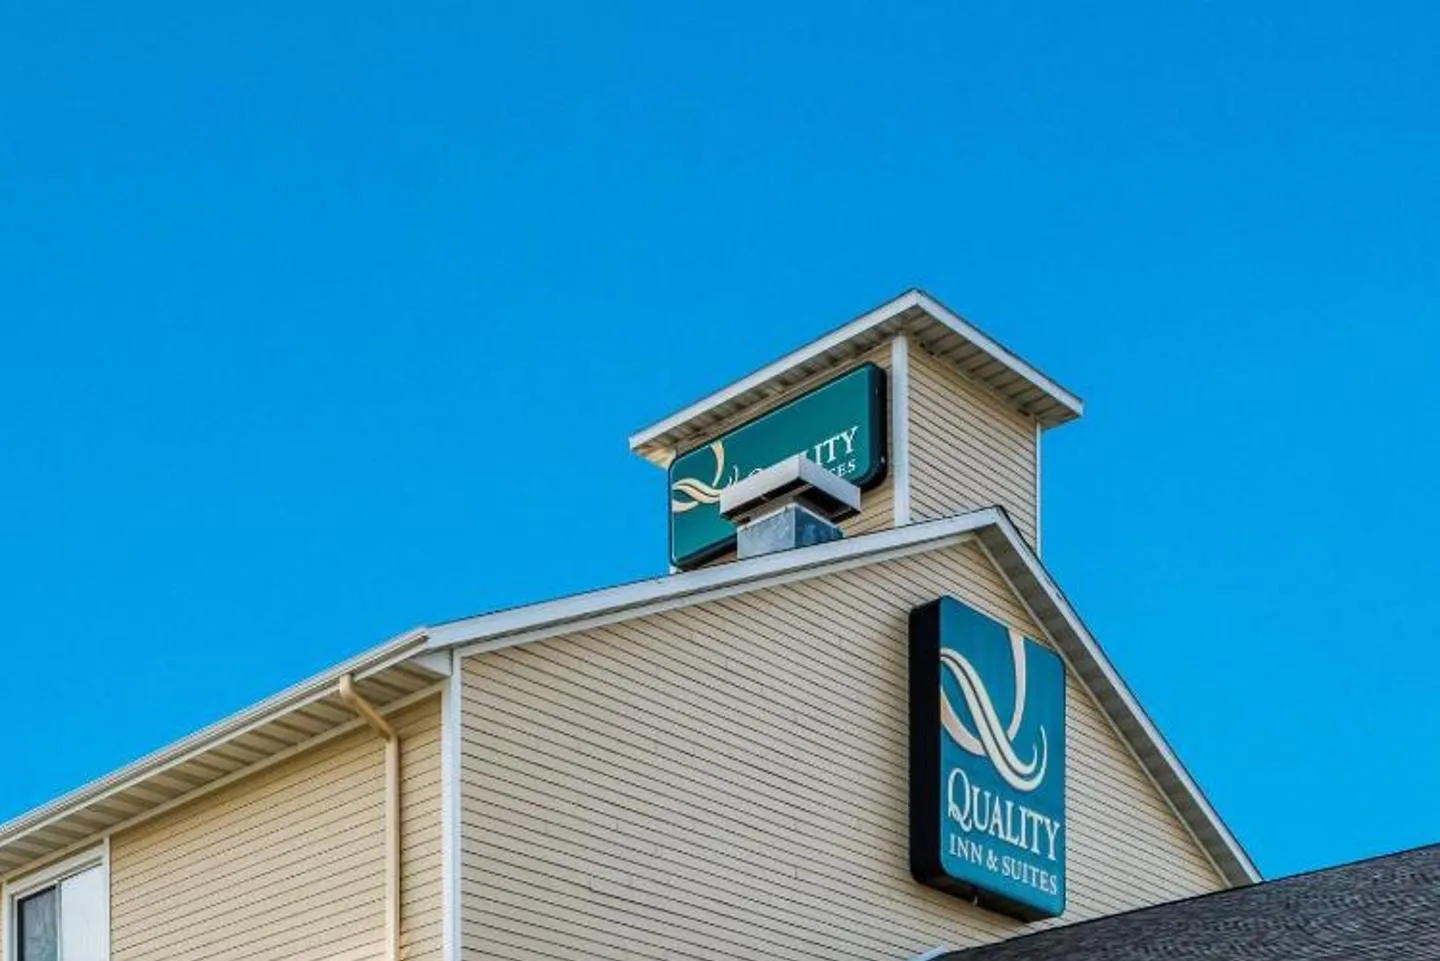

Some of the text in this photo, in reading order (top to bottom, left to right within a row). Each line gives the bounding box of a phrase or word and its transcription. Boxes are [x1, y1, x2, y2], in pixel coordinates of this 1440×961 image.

[948, 768, 1060, 861] QUALITY
[949, 833, 1057, 895] INN & SUITES
